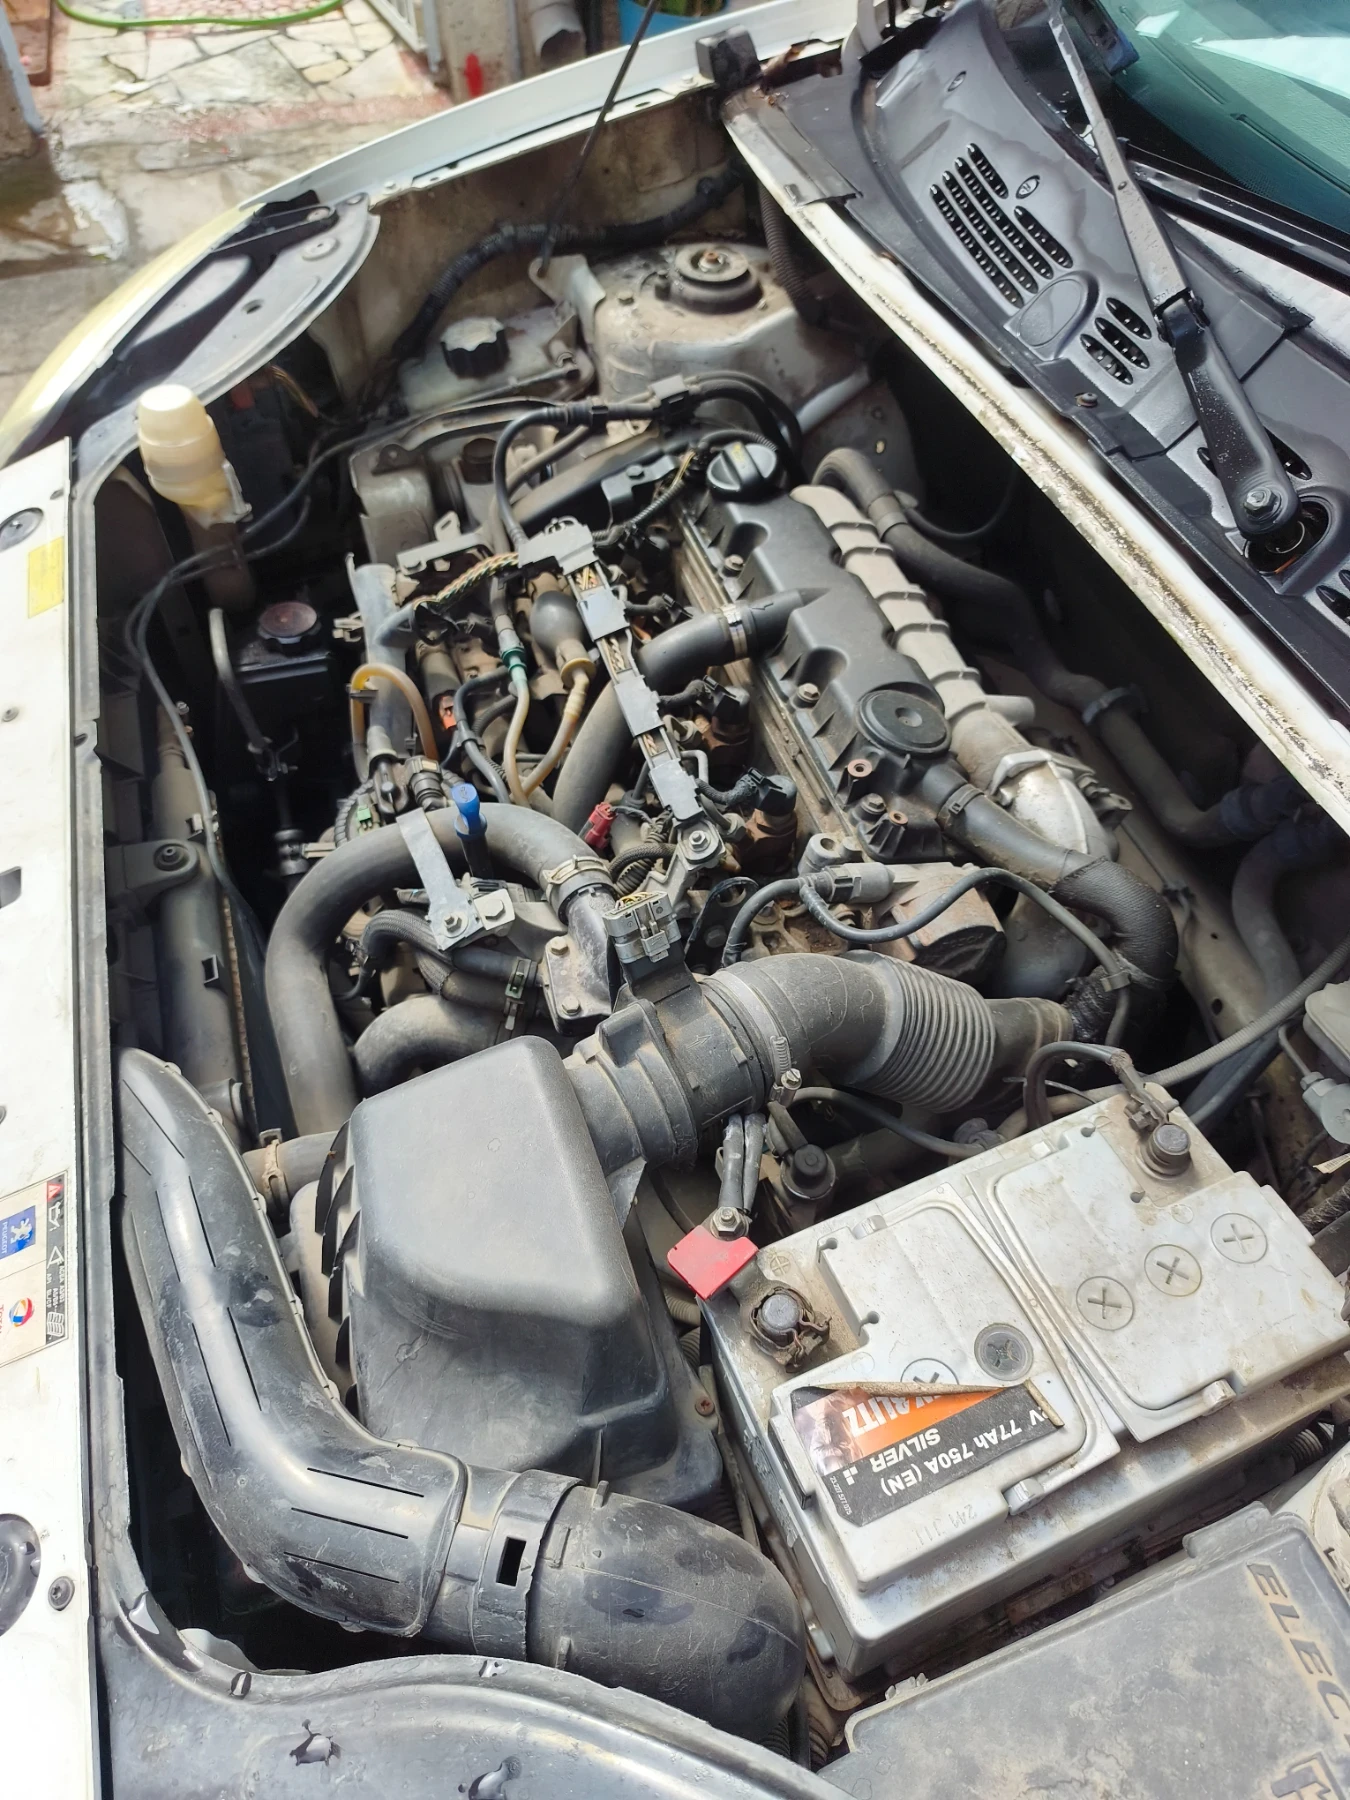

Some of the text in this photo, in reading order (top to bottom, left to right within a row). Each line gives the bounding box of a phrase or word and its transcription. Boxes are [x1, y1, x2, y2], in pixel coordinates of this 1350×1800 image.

[869, 1428, 941, 1473] SILVER
[973, 1419, 1022, 1449] 77Ah
[923, 1443, 974, 1475] 750A
[880, 1463, 922, 1497] (EN)
[1246, 1562, 1350, 1748] ELEC
